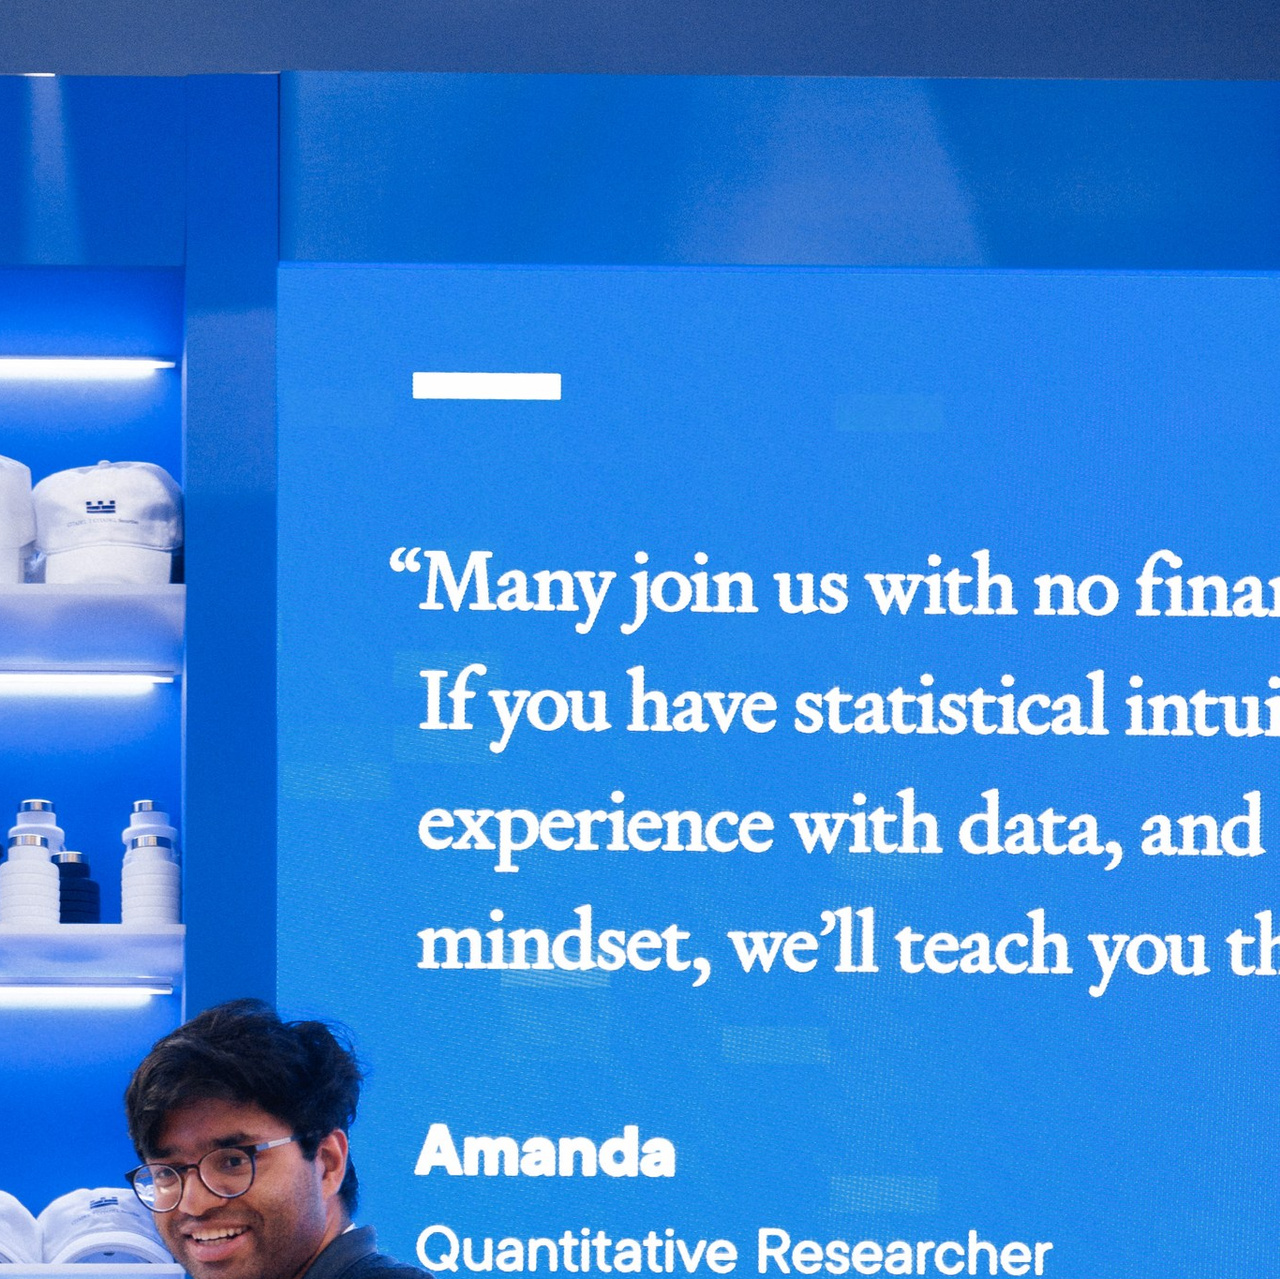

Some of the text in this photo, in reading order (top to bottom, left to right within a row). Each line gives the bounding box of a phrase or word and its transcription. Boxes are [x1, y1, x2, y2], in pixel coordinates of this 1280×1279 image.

[390, 547, 617, 634] “Many
[621, 551, 758, 634] join
[773, 573, 848, 614] us
[864, 549, 1018, 615] with
[1034, 574, 1119, 616] no
[420, 664, 487, 732] If
[489, 689, 612, 753] you
[626, 666, 777, 733] have
[795, 670, 1109, 735] statistical
[419, 788, 1266, 872] experience with data, and
[417, 904, 710, 987] mindset,
[727, 907, 879, 973] we’ll
[895, 908, 1073, 974] teach
[1088, 934, 1210, 997] you
[414, 1123, 675, 1177] Amanda
[416, 1225, 1053, 1275] Quantitative Researcher
